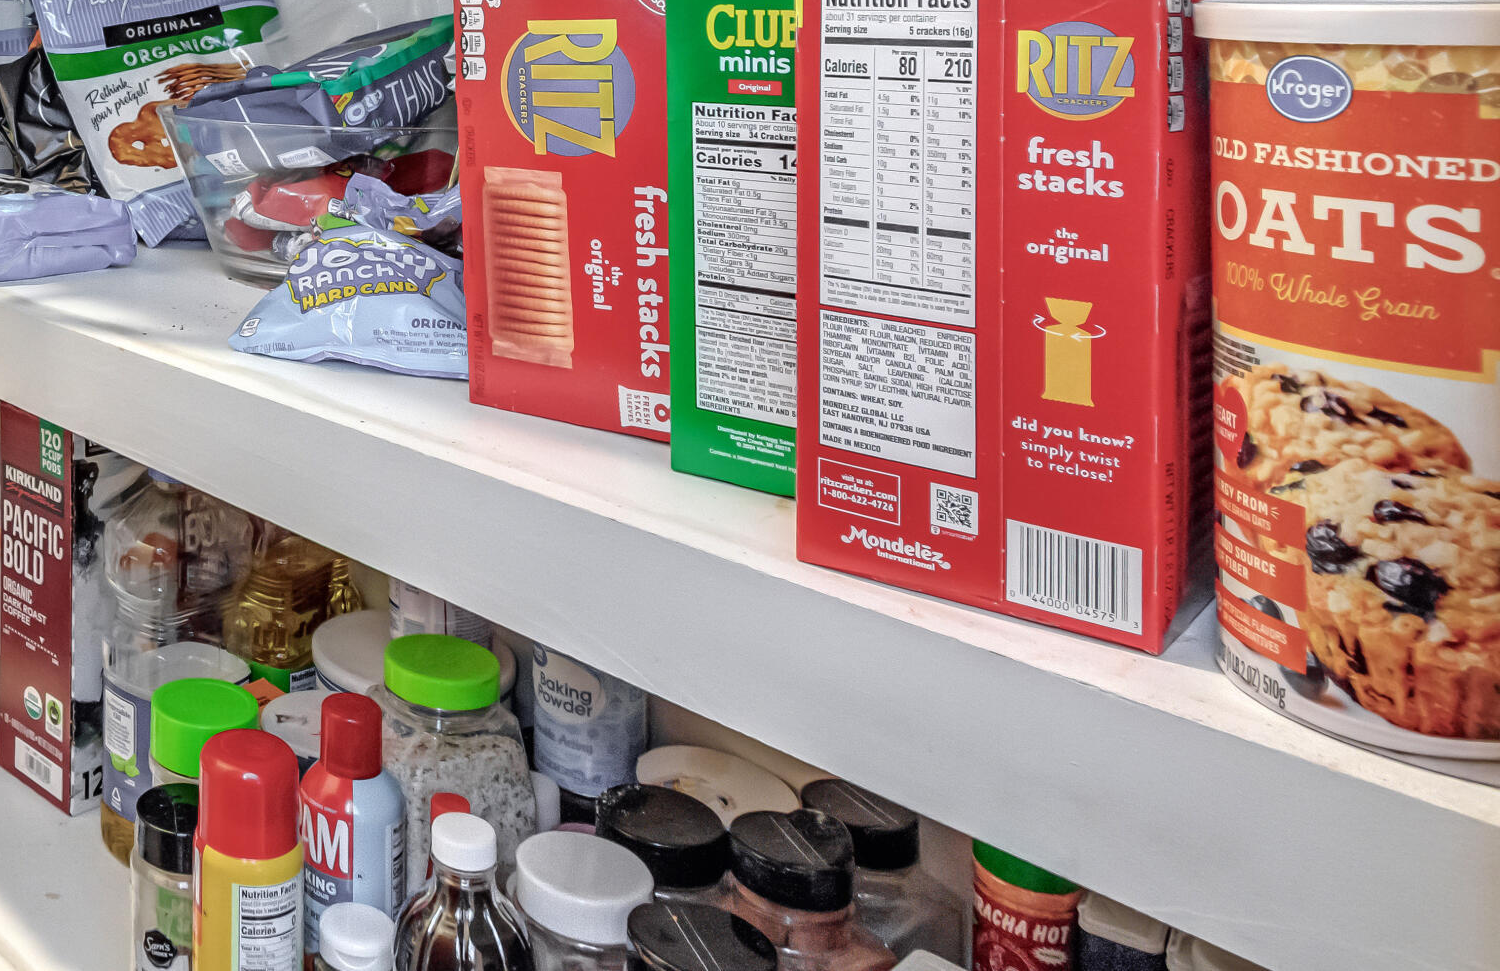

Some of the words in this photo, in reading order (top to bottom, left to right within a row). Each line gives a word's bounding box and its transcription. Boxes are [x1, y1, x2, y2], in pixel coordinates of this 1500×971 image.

[125, 17, 202, 38] ORIGINAL
[706, 4, 797, 50] CLUB
[825, 24, 851, 35] Serving
[853, 25, 868, 34] size
[909, 26, 914, 35] 5
[916, 27, 951, 36] crackers
[952, 27, 973, 38] (16g)
[122, 35, 216, 67] ORGANIC
[719, 49, 791, 75] minis
[1017, 29, 1136, 98] RITZ
[825, 58, 868, 74] Calories
[899, 56, 917, 76] 80
[944, 58, 972, 78] 210
[85, 78, 133, 108] Rethink
[385, 60, 445, 128] THINS
[518, 67, 528, 124] CRACKERS
[524, 19, 617, 158] RITZ
[738, 83, 771, 93] Original
[1056, 98, 1109, 107] CRACKERS
[1271, 69, 1346, 110] Kroger
[90, 108, 113, 131] your
[695, 105, 765, 121] Nutrition
[772, 109, 797, 122] Fac
[695, 128, 723, 139] Serving
[726, 130, 740, 138] size
[761, 132, 796, 142] Crackers
[696, 152, 762, 168] Calories
[779, 154, 797, 170] 14
[1027, 137, 1115, 170] fresh
[1214, 136, 1247, 161] OLD
[1254, 142, 1500, 182] FASHIONED
[1018, 169, 1125, 198] stacks
[633, 185, 669, 267] fresh
[1056, 228, 1079, 241] the
[1216, 179, 1487, 275] OATS
[1026, 240, 1110, 264] original
[298, 264, 404, 292] RANCH
[584, 238, 613, 310] original
[611, 266, 624, 286] the
[302, 285, 357, 310] HARD
[360, 280, 420, 295] CAND
[1226, 260, 1265, 292] 100%
[1270, 273, 1350, 309] Whole
[1354, 287, 1441, 322] Grain
[412, 318, 467, 331] ORIGIN
[637, 278, 670, 378] stacks
[634, 394, 642, 424] STACK
[642, 394, 650, 427] FRESH
[40, 428, 62, 451] 120
[823, 433, 842, 444] MADE
[845, 438, 852, 446] IN
[854, 440, 881, 453] MEXICO
[1011, 415, 1037, 432] did
[1042, 425, 1073, 439] you
[1078, 427, 1135, 449] know?
[41, 446, 62, 462] K-CUP
[41, 457, 62, 476] PODS
[1021, 438, 1073, 463] simply
[1079, 450, 1121, 468] twist
[4, 464, 63, 505] KIRKLAND
[1027, 456, 1043, 469] to
[1049, 462, 1113, 483] reclose!
[820, 475, 897, 502] ritzcrackers.com
[822, 487, 894, 513] 1-800-622-4726
[1236, 490, 1268, 516] FROM
[3, 498, 65, 561] PACIFIC
[3, 533, 45, 586] BOLD
[840, 525, 952, 570] Mondelēz
[877, 549, 936, 571] International
[1235, 544, 1277, 578] SOURCE
[1225, 556, 1249, 580] FIBER
[3, 575, 33, 605] ORGANIC
[3, 593, 22, 610] DARK
[22, 602, 48, 626] ROAST
[3, 603, 32, 627] COFFEE
[539, 684, 593, 718] Powder
[540, 670, 592, 706] Baking
[1262, 673, 1287, 709] 510g
[81, 769, 102, 801] 12
[302, 803, 349, 875] AM
[241, 888, 279, 900] Nutrition
[304, 867, 338, 897] KING
[241, 925, 277, 936] Calories
[973, 894, 1028, 940] RACHA
[1032, 924, 1070, 946] HOT
[144, 936, 172, 954] Sam's
